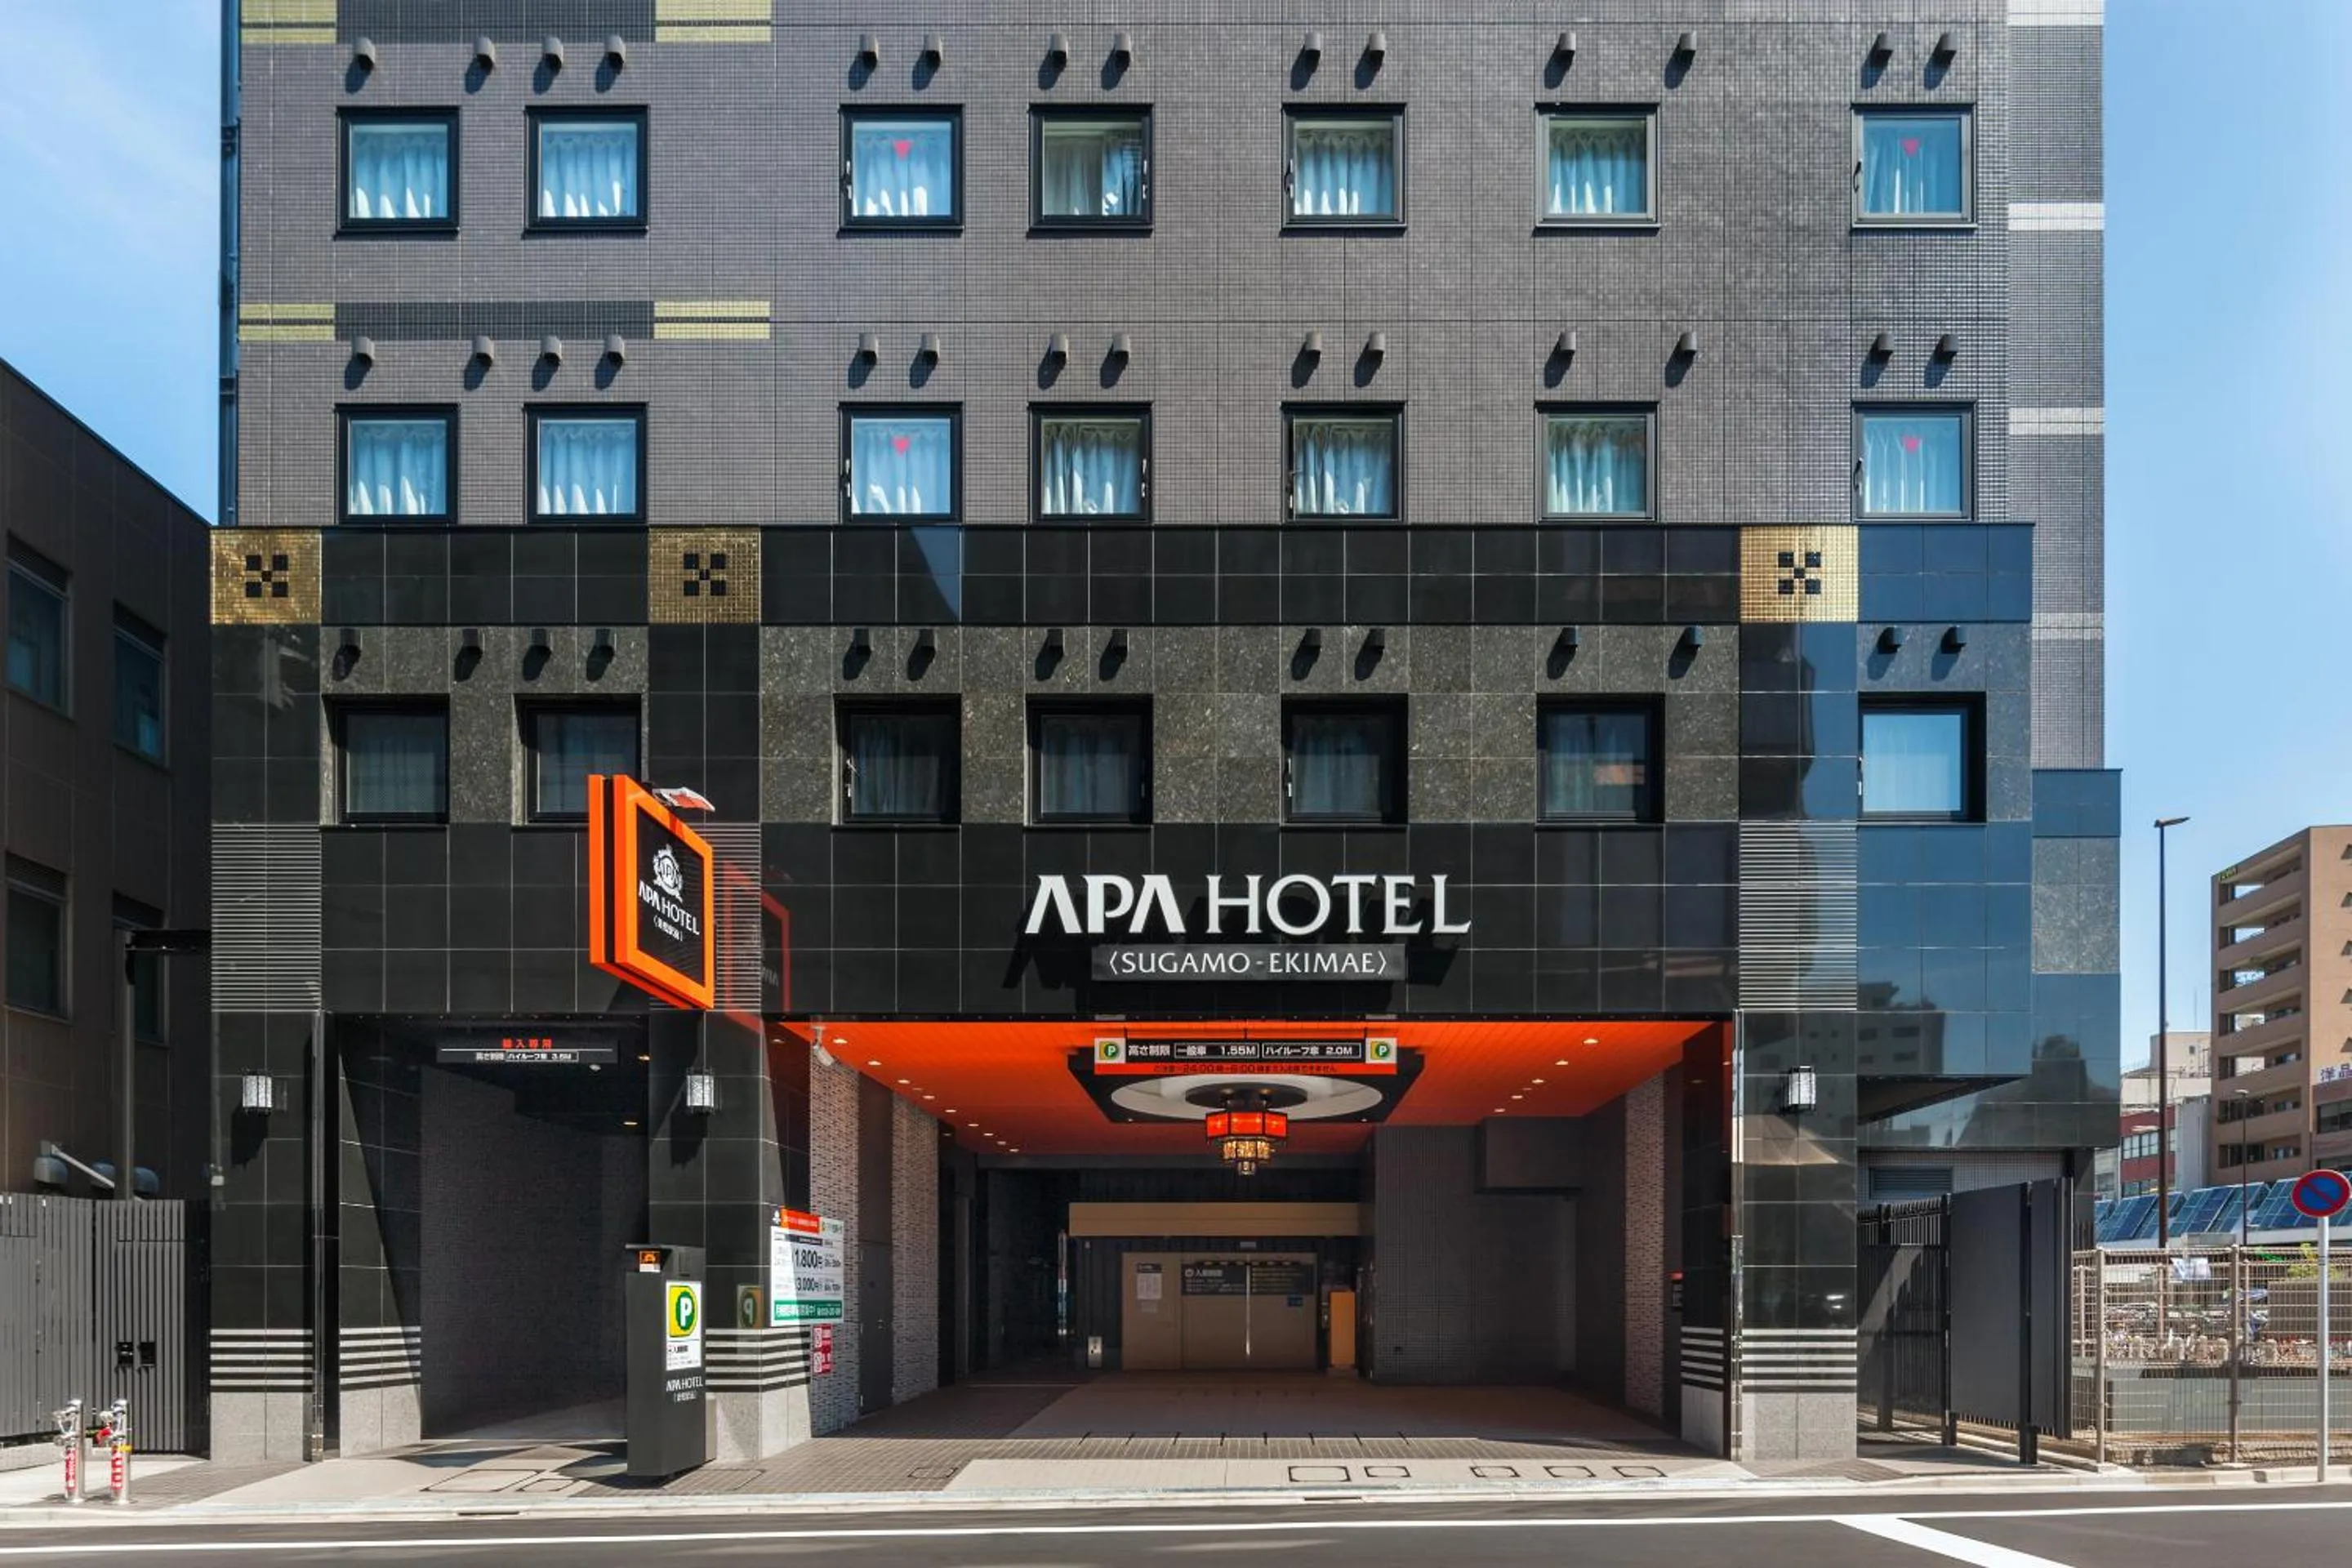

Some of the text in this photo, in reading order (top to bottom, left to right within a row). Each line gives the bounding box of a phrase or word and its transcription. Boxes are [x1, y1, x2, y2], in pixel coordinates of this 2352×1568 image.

[638, 880, 661, 912] APA
[661, 896, 700, 936] HOTEL
[1024, 873, 1472, 937] APA HOTEL
[1128, 1045, 1170, 1056] 高さ制限
[1220, 1045, 1256, 1056] 1.55M
[1325, 1045, 1352, 1055] 2.0M
[679, 1299, 694, 1327] P
